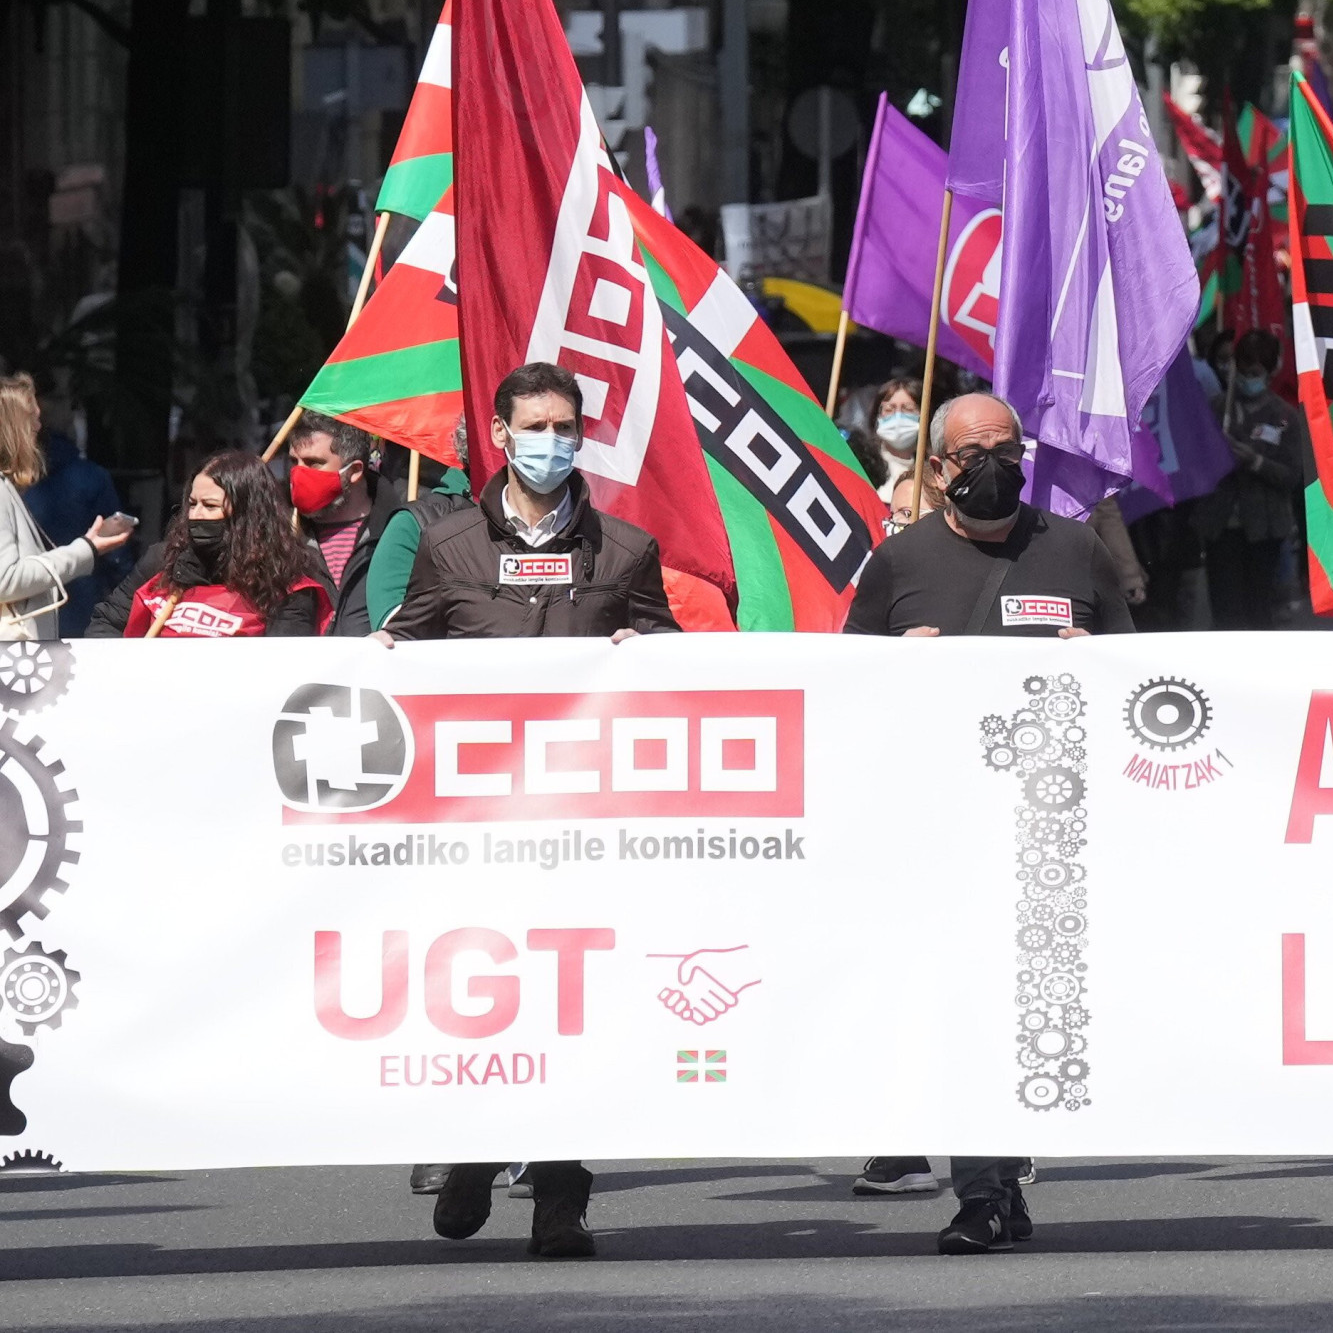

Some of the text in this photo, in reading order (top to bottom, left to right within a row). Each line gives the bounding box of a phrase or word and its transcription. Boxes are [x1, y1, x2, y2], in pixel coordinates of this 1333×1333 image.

[522, 561, 567, 574] CCOO
[1024, 602, 1068, 616] CCOO
[434, 716, 777, 798] CCOO
[1121, 752, 1224, 791] MAIATZAK
[281, 827, 806, 871] euskadiko langile komisioak
[313, 926, 617, 1041] UGT
[379, 1053, 546, 1089] EUSKADI
